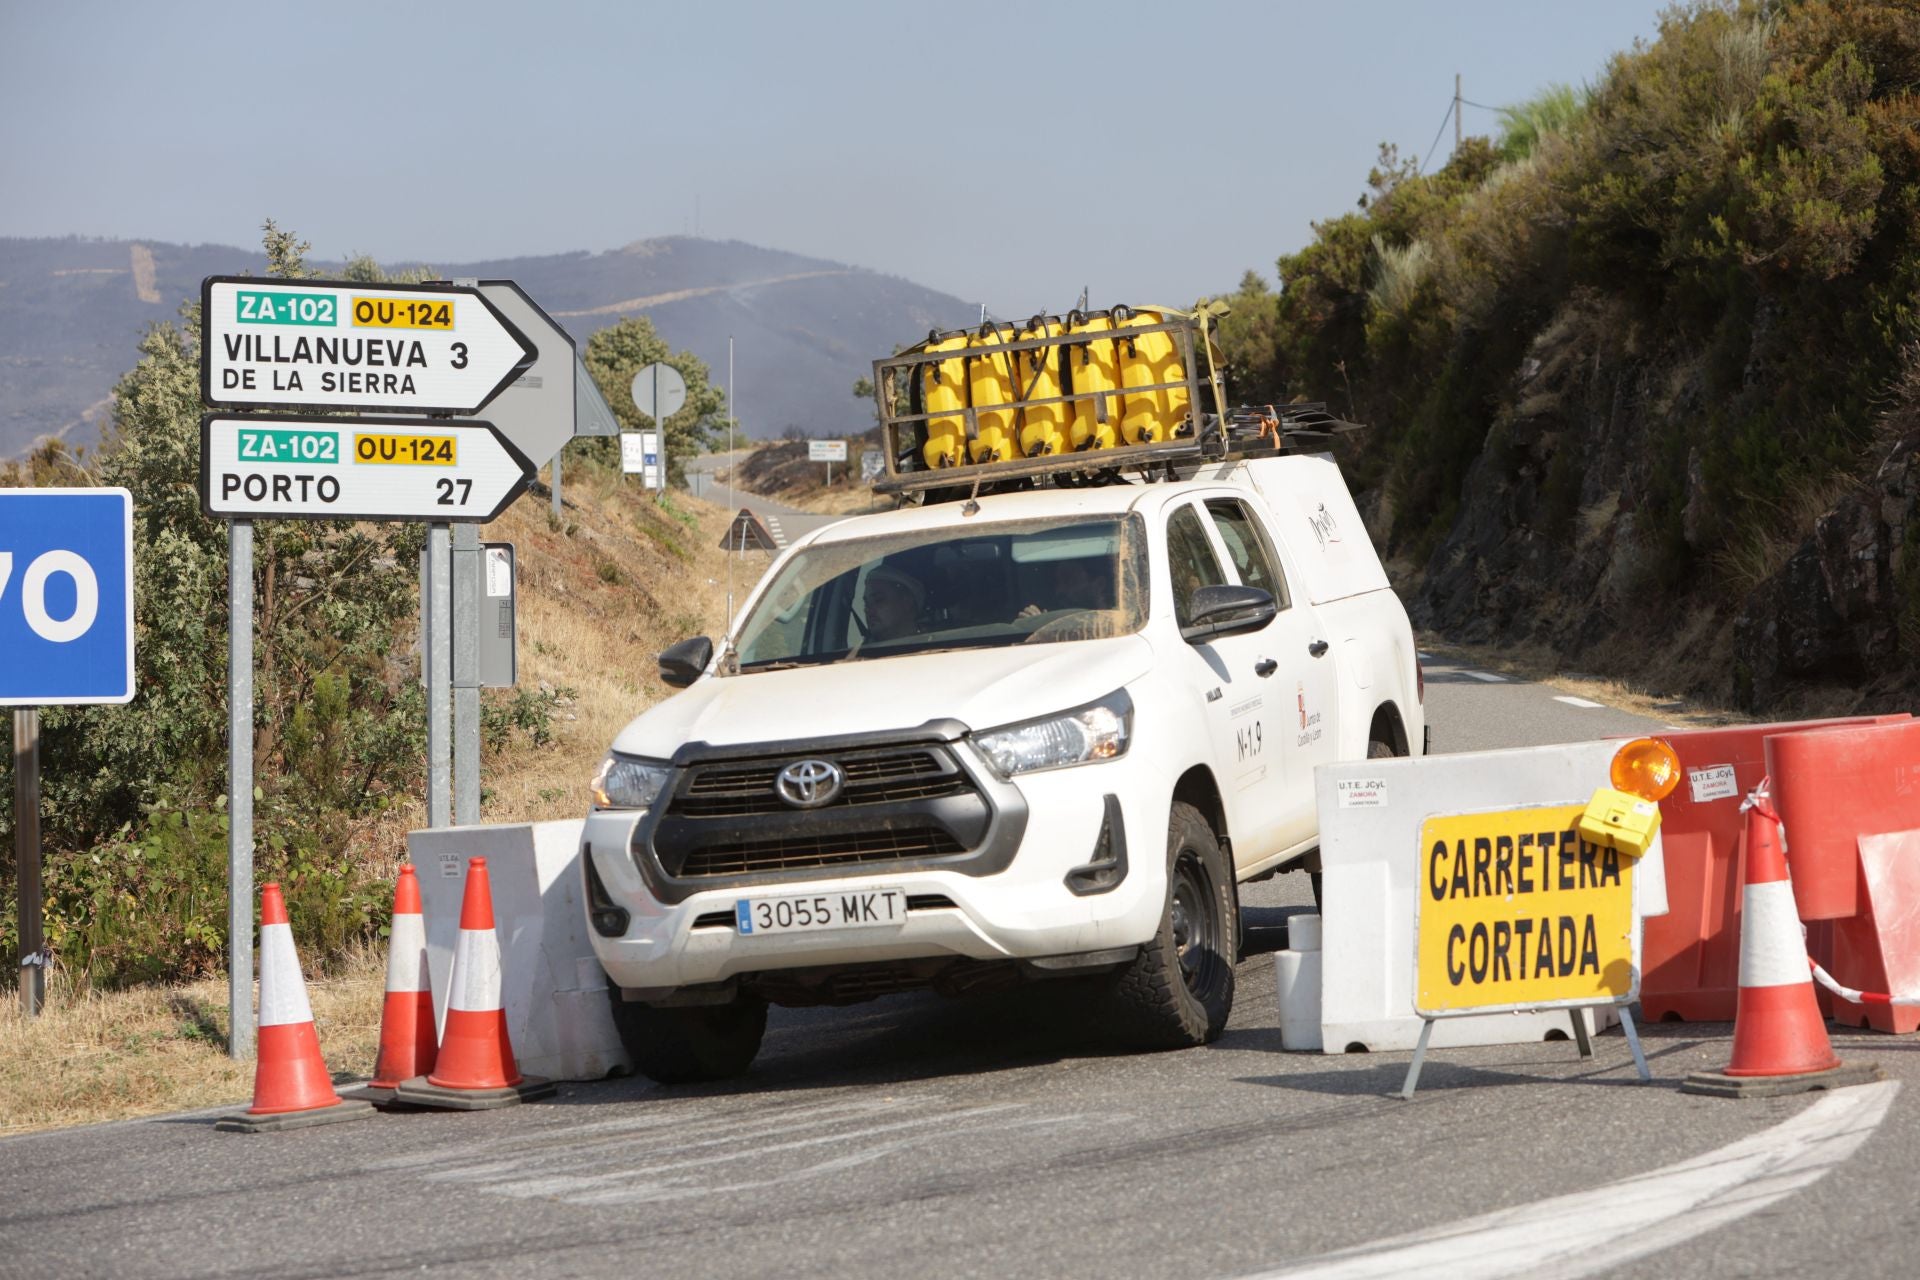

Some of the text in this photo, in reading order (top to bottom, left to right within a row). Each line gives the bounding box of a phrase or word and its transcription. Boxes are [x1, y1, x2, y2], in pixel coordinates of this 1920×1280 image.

[240, 296, 334, 323] ZA-102
[355, 300, 451, 326] OU-124
[224, 334, 469, 369] VILLANUEVA 3
[223, 368, 416, 395] DE LA SIERRA
[241, 434, 335, 459] ZA-102
[357, 438, 453, 462] OU-124
[222, 473, 472, 505] PORTO 27
[0, 549, 99, 643] 0
[1702, 781, 1727, 789] ZAMORA
[1429, 829, 1621, 902] CARRETERA
[757, 892, 897, 929] 3055 MKT
[1447, 914, 1600, 987] CORTADA
